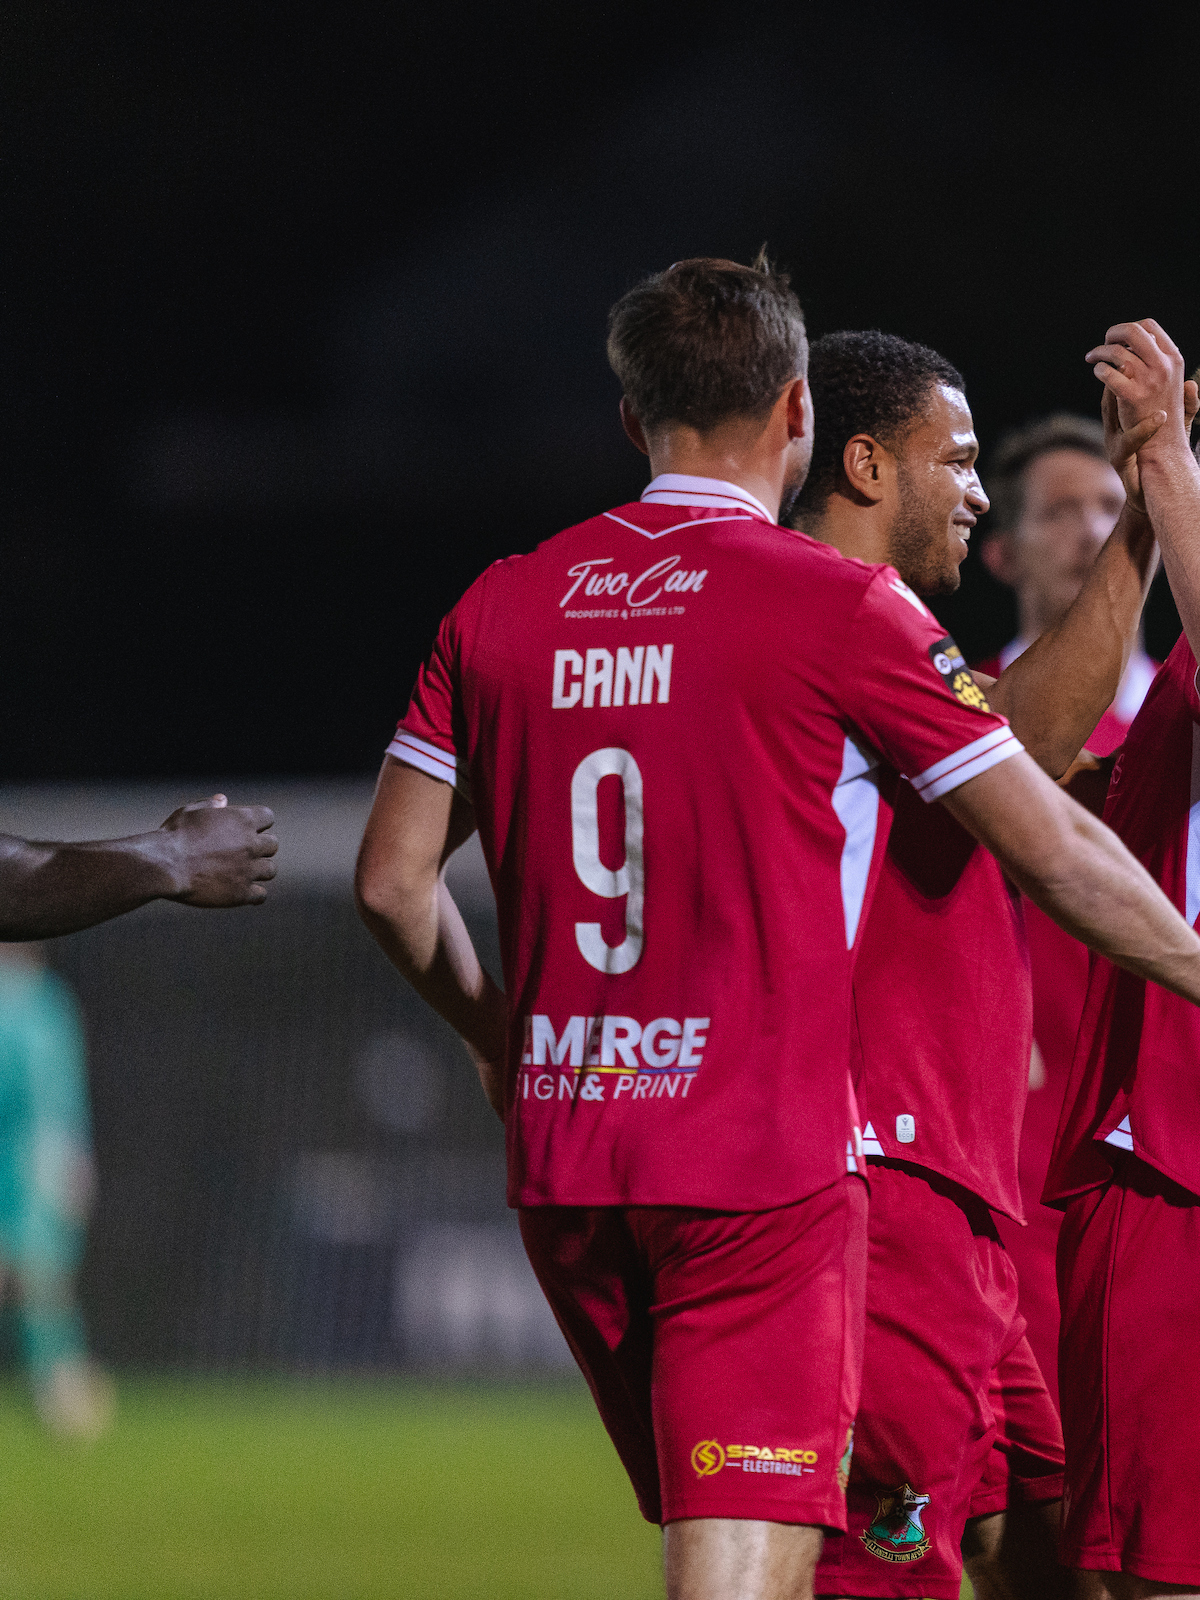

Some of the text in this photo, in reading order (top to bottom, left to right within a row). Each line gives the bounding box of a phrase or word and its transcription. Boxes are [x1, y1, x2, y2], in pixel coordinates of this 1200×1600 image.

[560, 555, 708, 608] Two Can
[564, 606, 686, 620] PROPERTIES & ESTATES LTD
[551, 644, 674, 709] CANN
[571, 747, 644, 975] 9
[522, 1013, 711, 1067] MERGE
[517, 1072, 697, 1102] IGN & PRINT
[726, 1444, 818, 1465] SPARCO
[742, 1459, 802, 1477] ELECTRICAL
